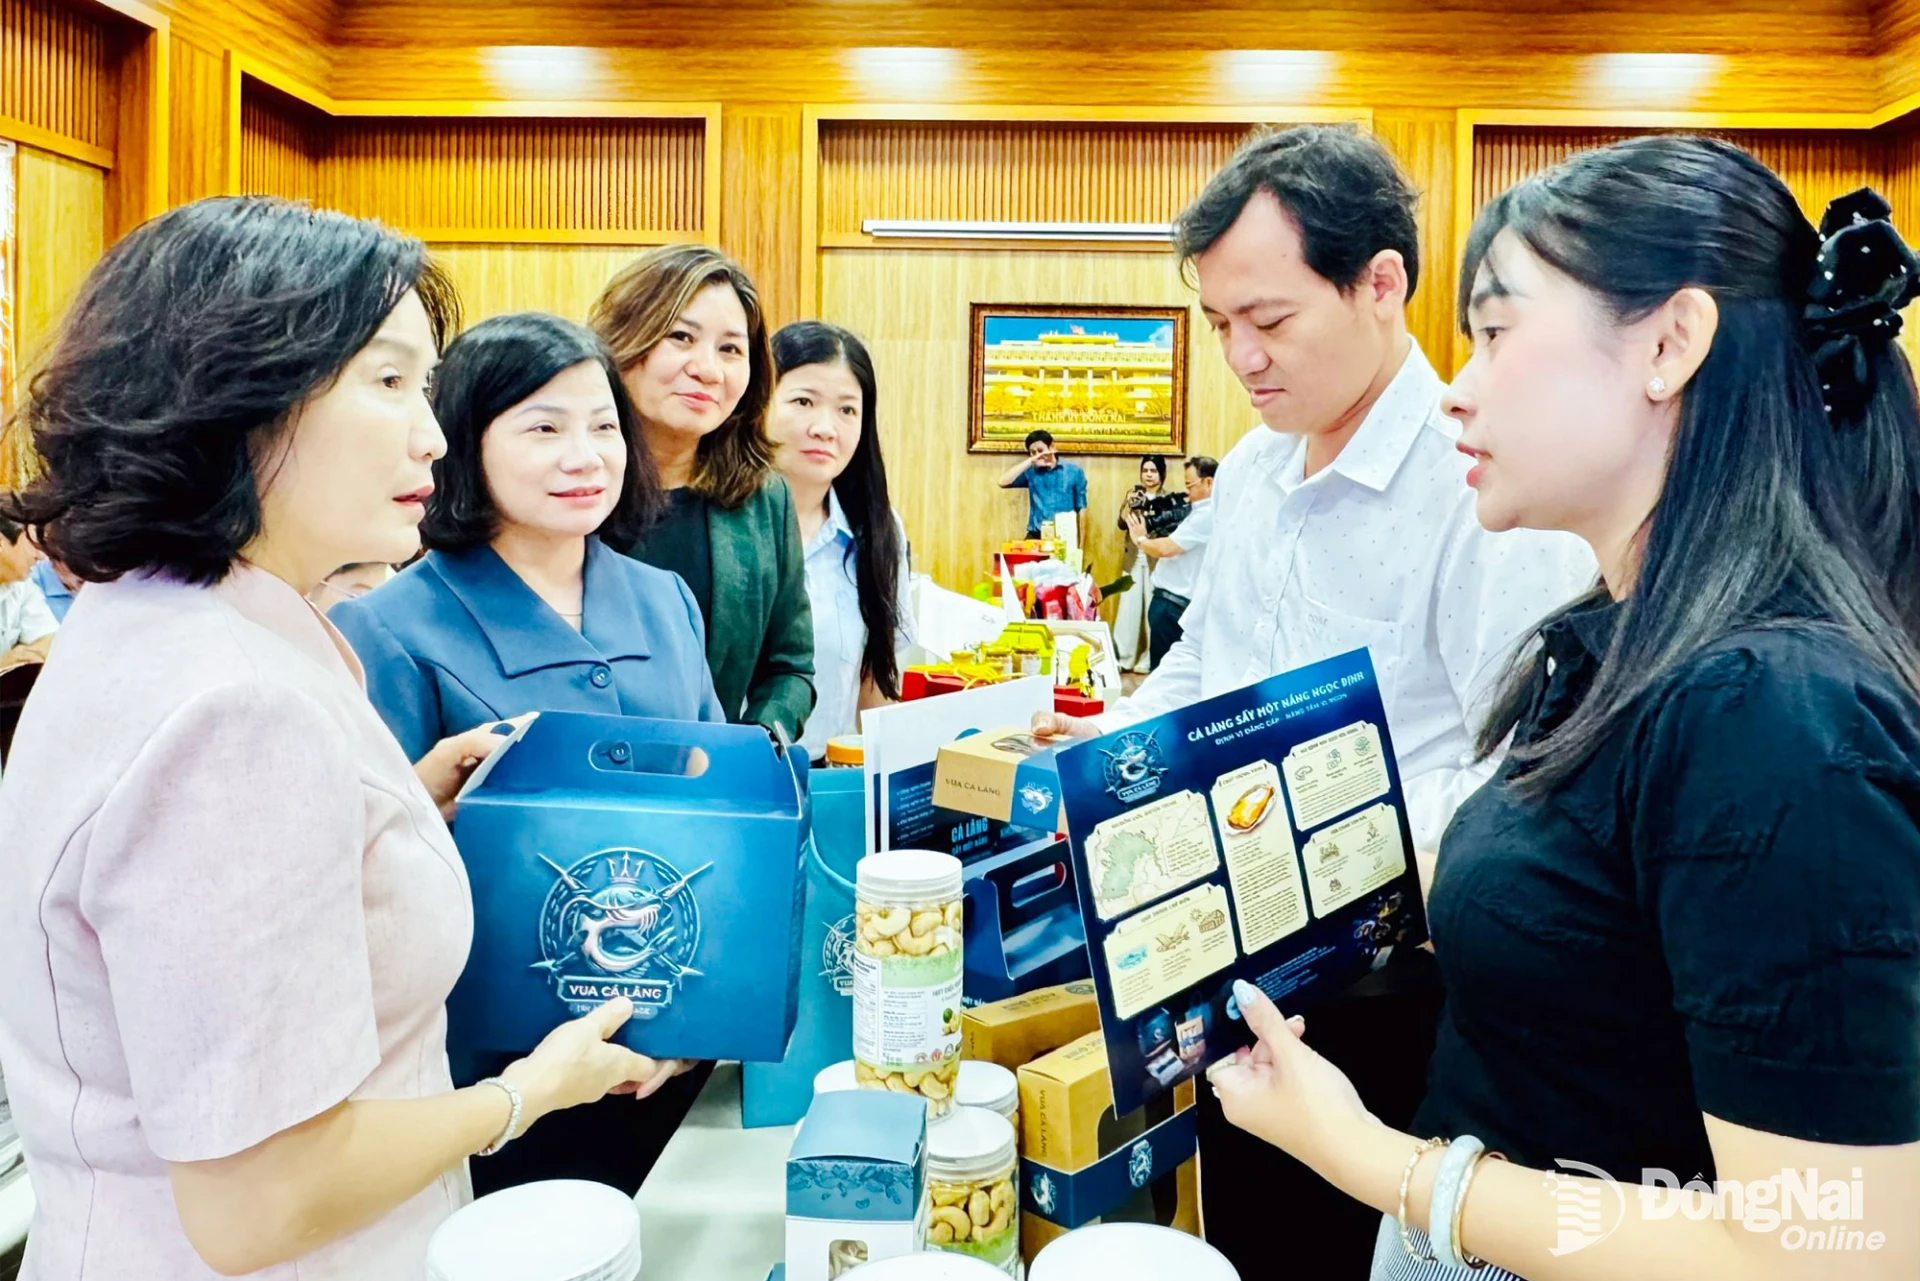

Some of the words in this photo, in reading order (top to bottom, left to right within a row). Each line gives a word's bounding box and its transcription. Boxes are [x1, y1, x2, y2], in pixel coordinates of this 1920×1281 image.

[1187, 726, 1205, 742] CÁ
[1235, 708, 1255, 726] SẤY
[1256, 701, 1280, 718] MỘT
[1311, 680, 1340, 698] NGỌC
[1340, 671, 1365, 688] ĐỊNH
[951, 822, 964, 843] CÁ
[569, 984, 599, 997] VUA
[601, 983, 620, 997] CÁ
